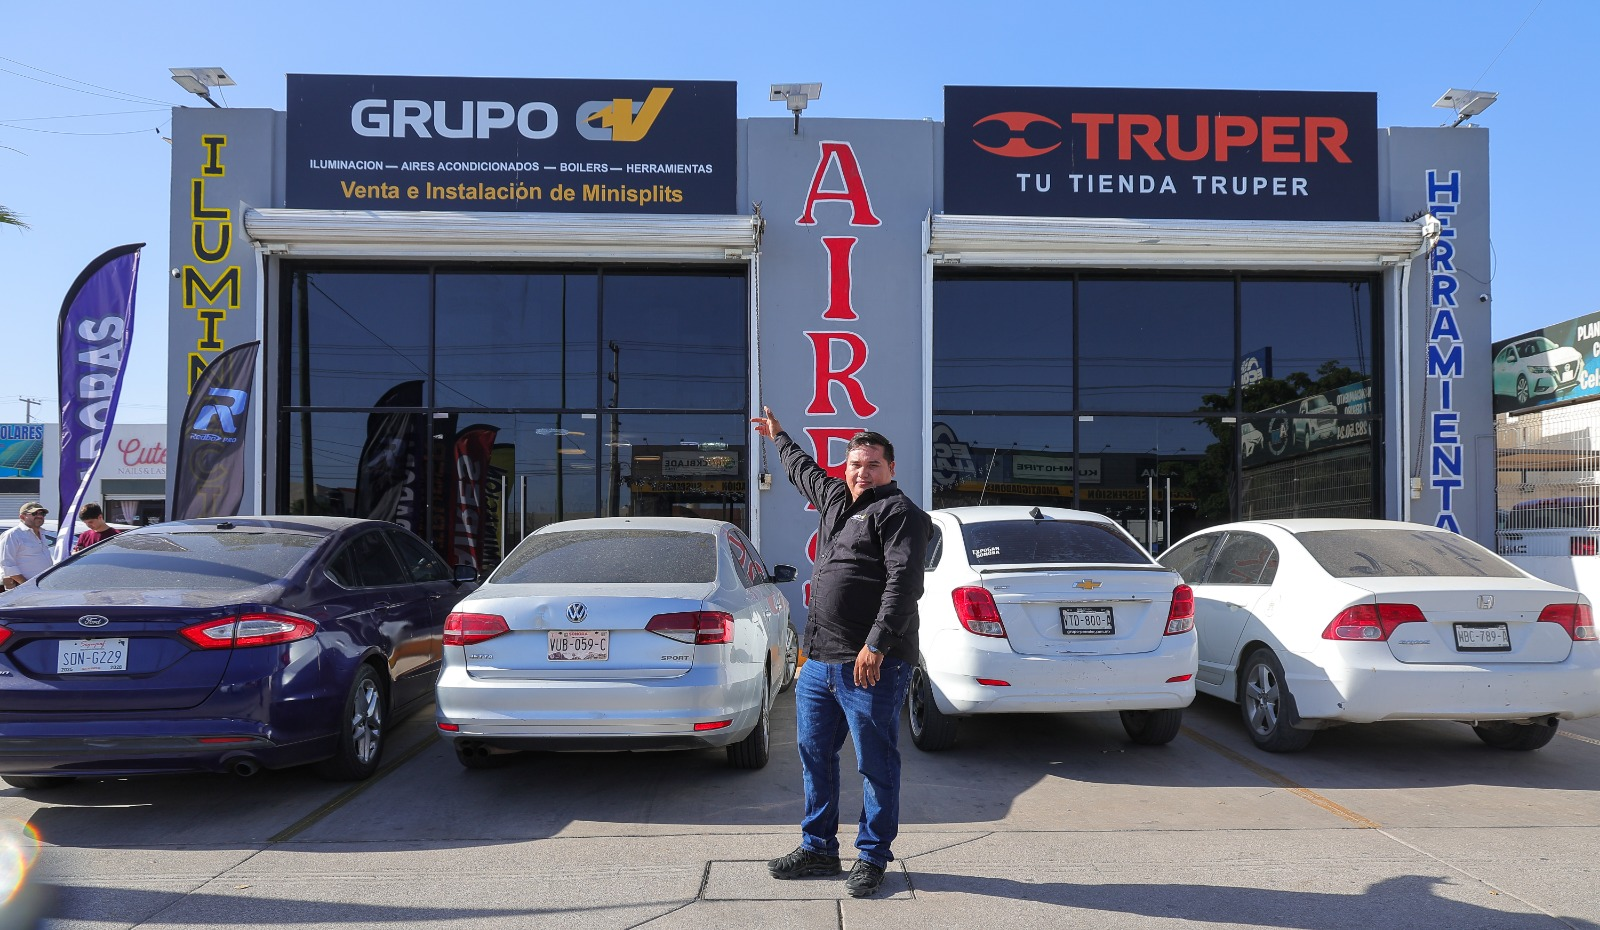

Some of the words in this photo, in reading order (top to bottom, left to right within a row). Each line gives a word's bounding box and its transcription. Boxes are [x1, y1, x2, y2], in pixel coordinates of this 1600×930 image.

[351, 99, 558, 139] GRUPO
[1071, 113, 1352, 164] TRUPER
[310, 159, 383, 171] ILUMINACION
[401, 161, 435, 172] AIRES
[437, 161, 540, 173] ACONDICIONADOS
[560, 162, 609, 174] BOILERS
[626, 163, 713, 175] HERRAMIENTAS
[340, 180, 399, 200] Venta
[407, 185, 419, 200] e
[426, 181, 542, 200] Instalación
[550, 183, 576, 202] de
[582, 184, 684, 206] Minisplits
[1016, 173, 1051, 192] TU
[1069, 174, 1177, 194] TIENDA
[1192, 175, 1309, 196] TRUPER
[550, 638, 606, 652] VUB-059-C
